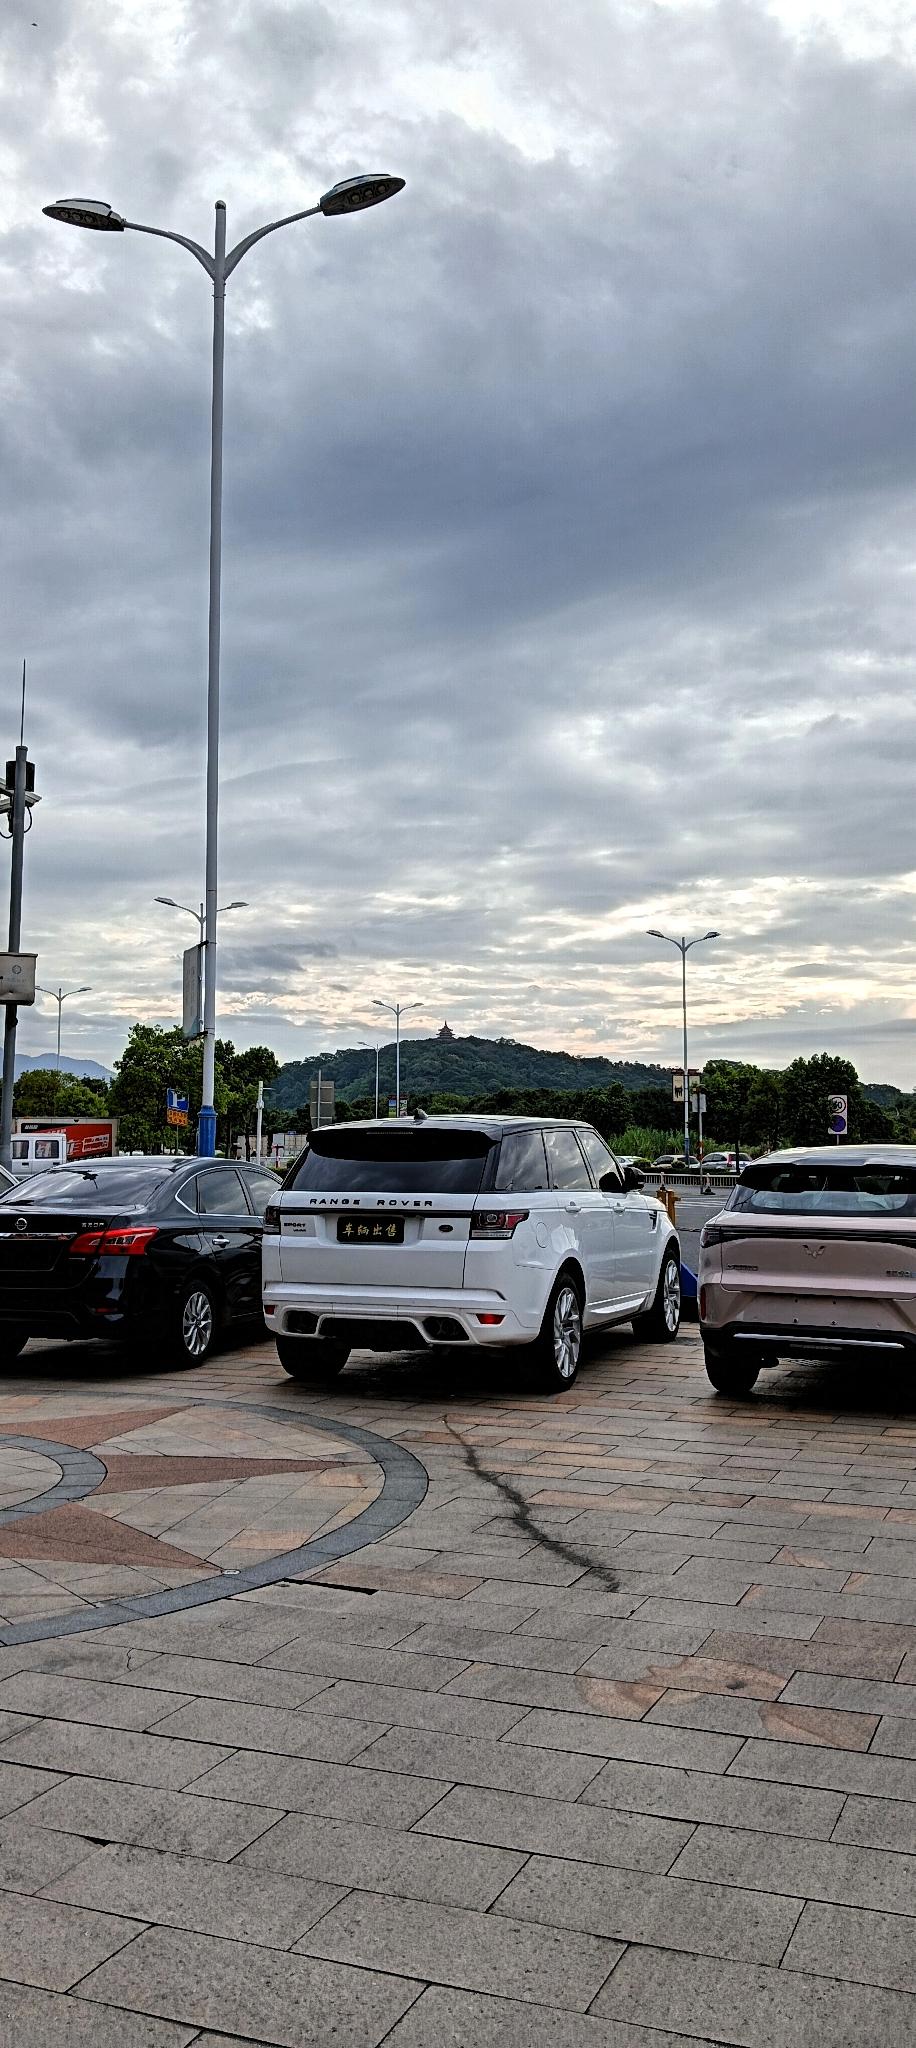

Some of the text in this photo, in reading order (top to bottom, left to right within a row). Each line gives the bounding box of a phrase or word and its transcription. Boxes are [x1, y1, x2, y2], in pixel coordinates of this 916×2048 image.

[309, 1198, 433, 1207] RANGE ROVER
[342, 1222, 397, 1237] 车辆出售
